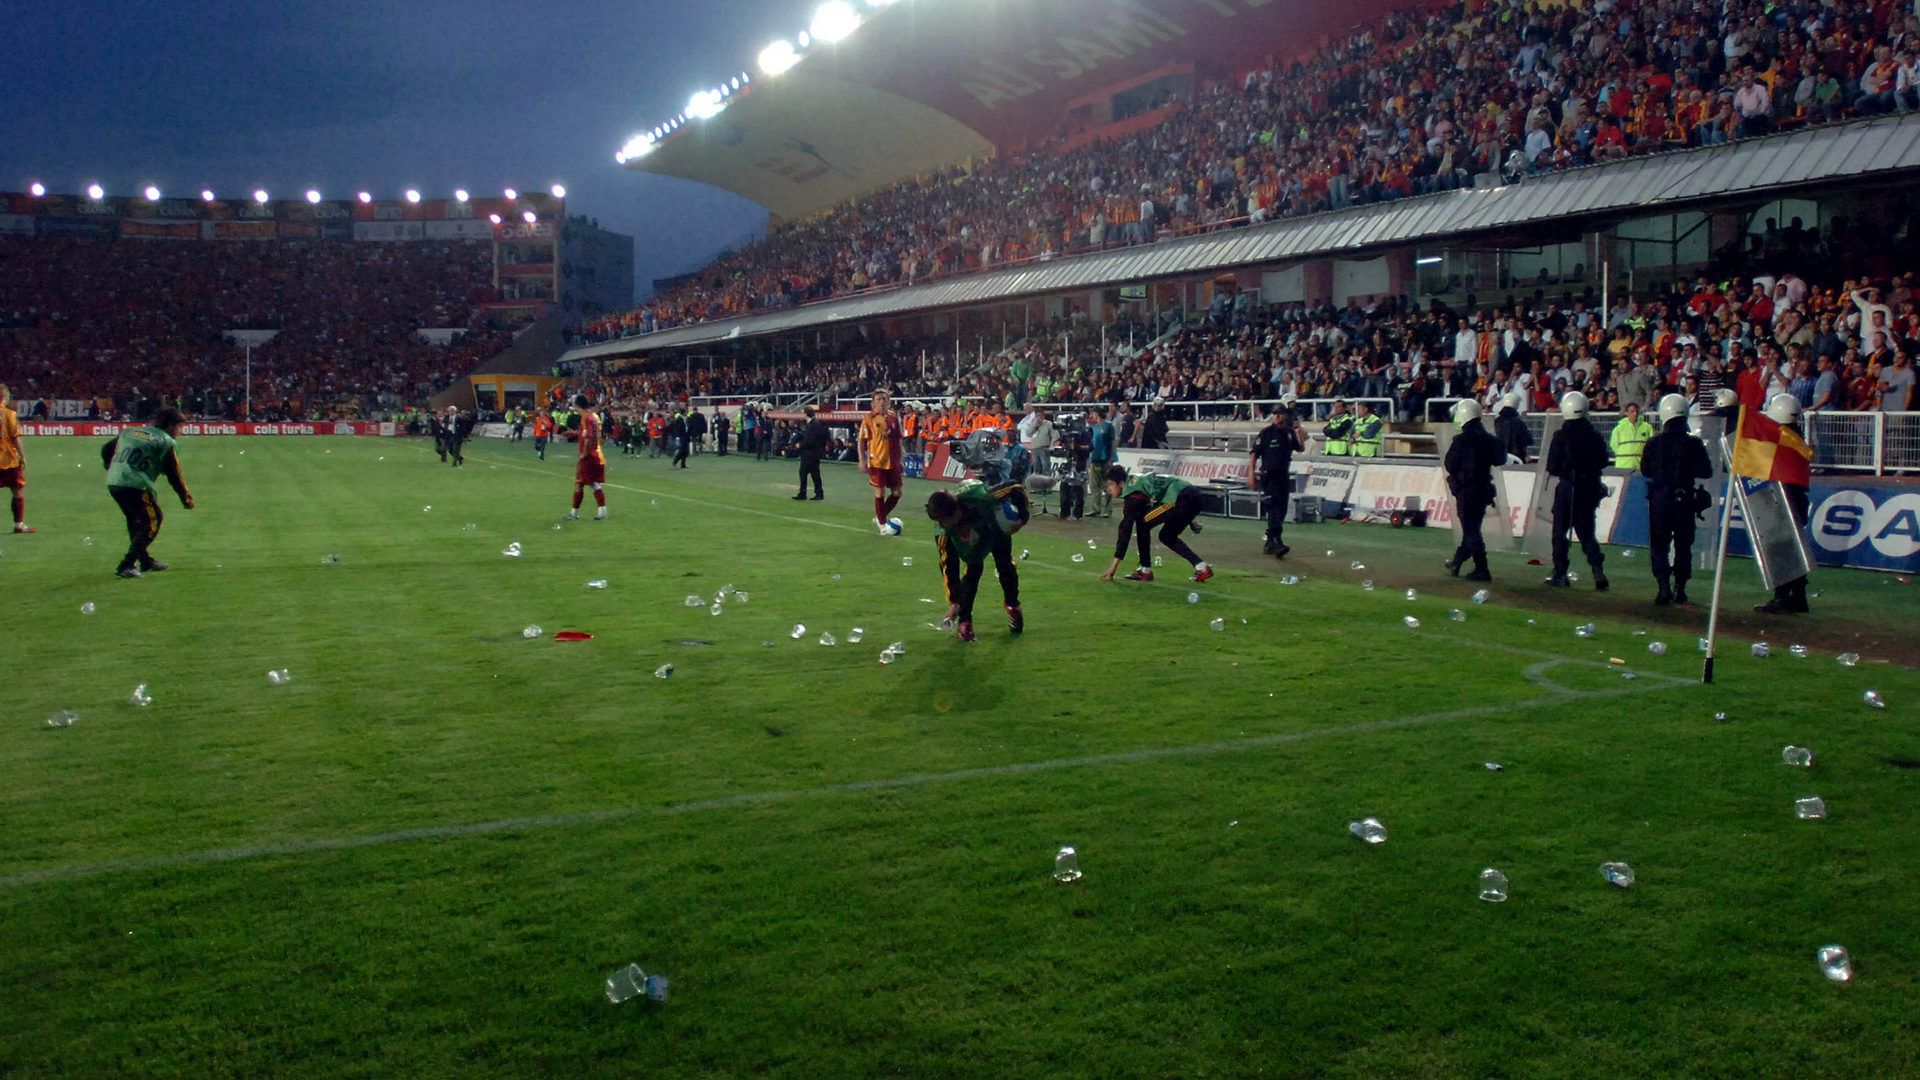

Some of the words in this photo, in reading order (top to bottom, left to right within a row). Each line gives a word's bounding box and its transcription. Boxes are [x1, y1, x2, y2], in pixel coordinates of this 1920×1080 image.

[515, 222, 552, 238] avea
[39, 424, 74, 435] turka
[93, 424, 119, 435] cola
[182, 424, 200, 434] ola
[204, 424, 236, 435] turka
[254, 424, 279, 435] cola
[282, 424, 314, 435] turka
